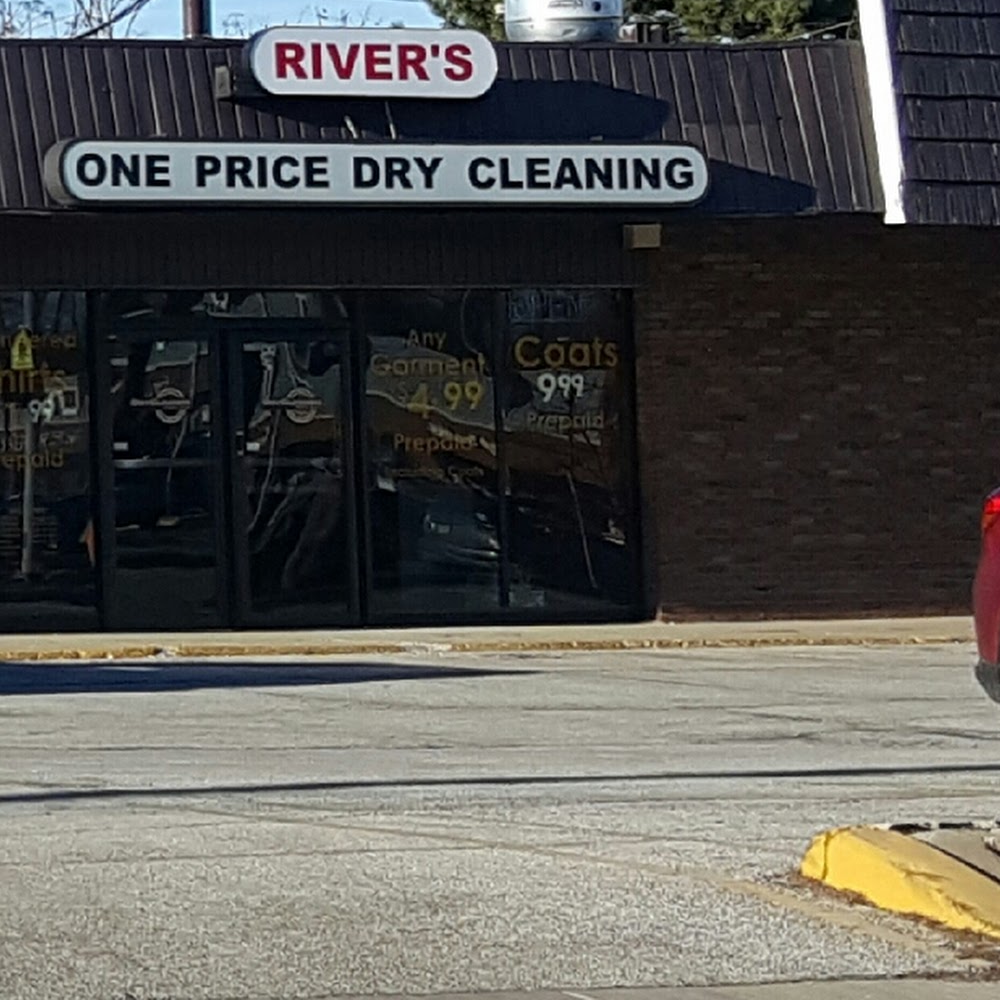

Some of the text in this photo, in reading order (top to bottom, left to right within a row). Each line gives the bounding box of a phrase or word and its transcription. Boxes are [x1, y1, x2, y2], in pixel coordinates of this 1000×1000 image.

[275, 43, 473, 81] RIVER'S
[75, 153, 695, 190] ONE PRICE DRY CLEANING
[405, 329, 447, 351] Any
[514, 335, 618, 368] Coats
[369, 354, 486, 378] Garment
[527, 411, 604, 433] Prepaid
[394, 433, 478, 455] Prepaid
